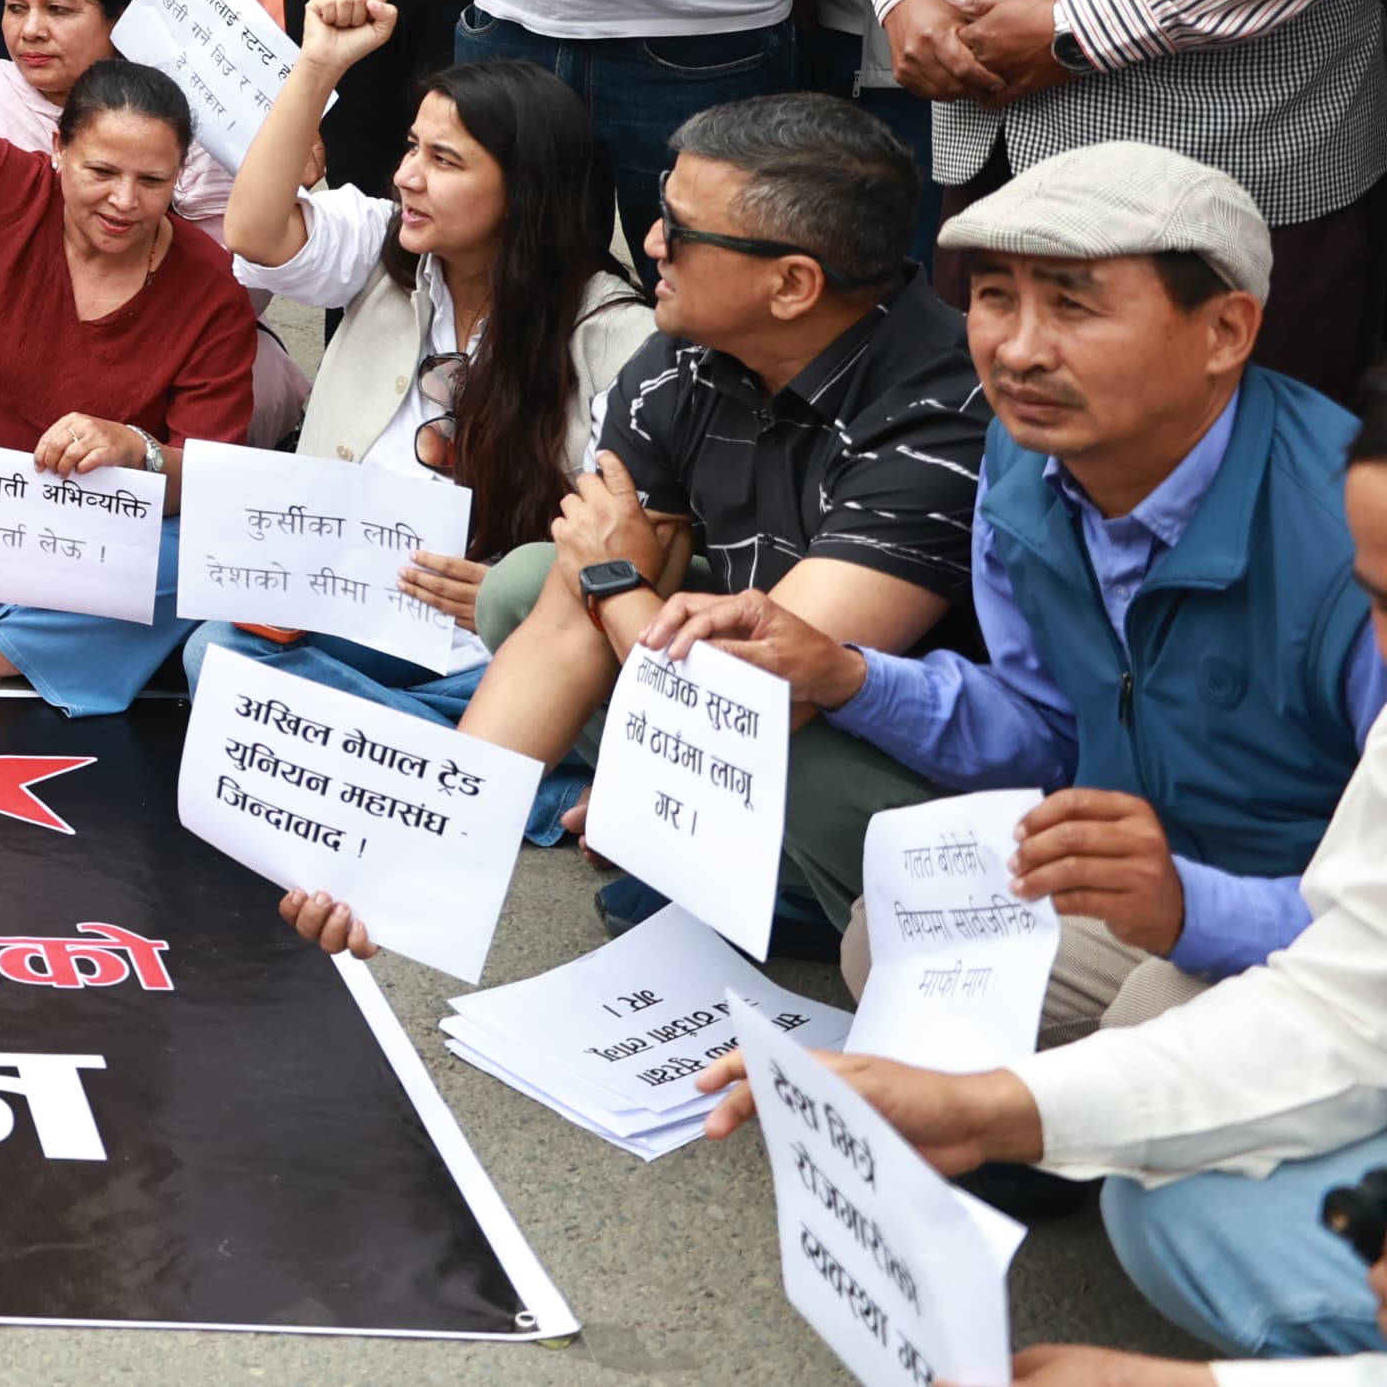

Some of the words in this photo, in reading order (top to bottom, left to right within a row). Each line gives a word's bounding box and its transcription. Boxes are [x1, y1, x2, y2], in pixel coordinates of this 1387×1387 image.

[189, 71, 227, 118] सरकार
[42, 480, 152, 520] अभिव्यक्ति
[37, 527, 87, 561] लेऊ
[244, 504, 347, 542] कुर्सीका
[360, 522, 425, 552] लागि
[205, 555, 292, 593] देशको
[306, 567, 371, 605] सीमा
[635, 655, 700, 710] सामाजिक
[704, 689, 760, 741] सुरक्षा
[234, 693, 335, 748] अखिल
[341, 727, 432, 780] नेपाल
[436, 758, 487, 798] ट्रेड
[224, 737, 334, 798] युनियन
[338, 781, 451, 837] महासंघ
[709, 754, 755, 813] लागू
[654, 789, 685, 831] गर
